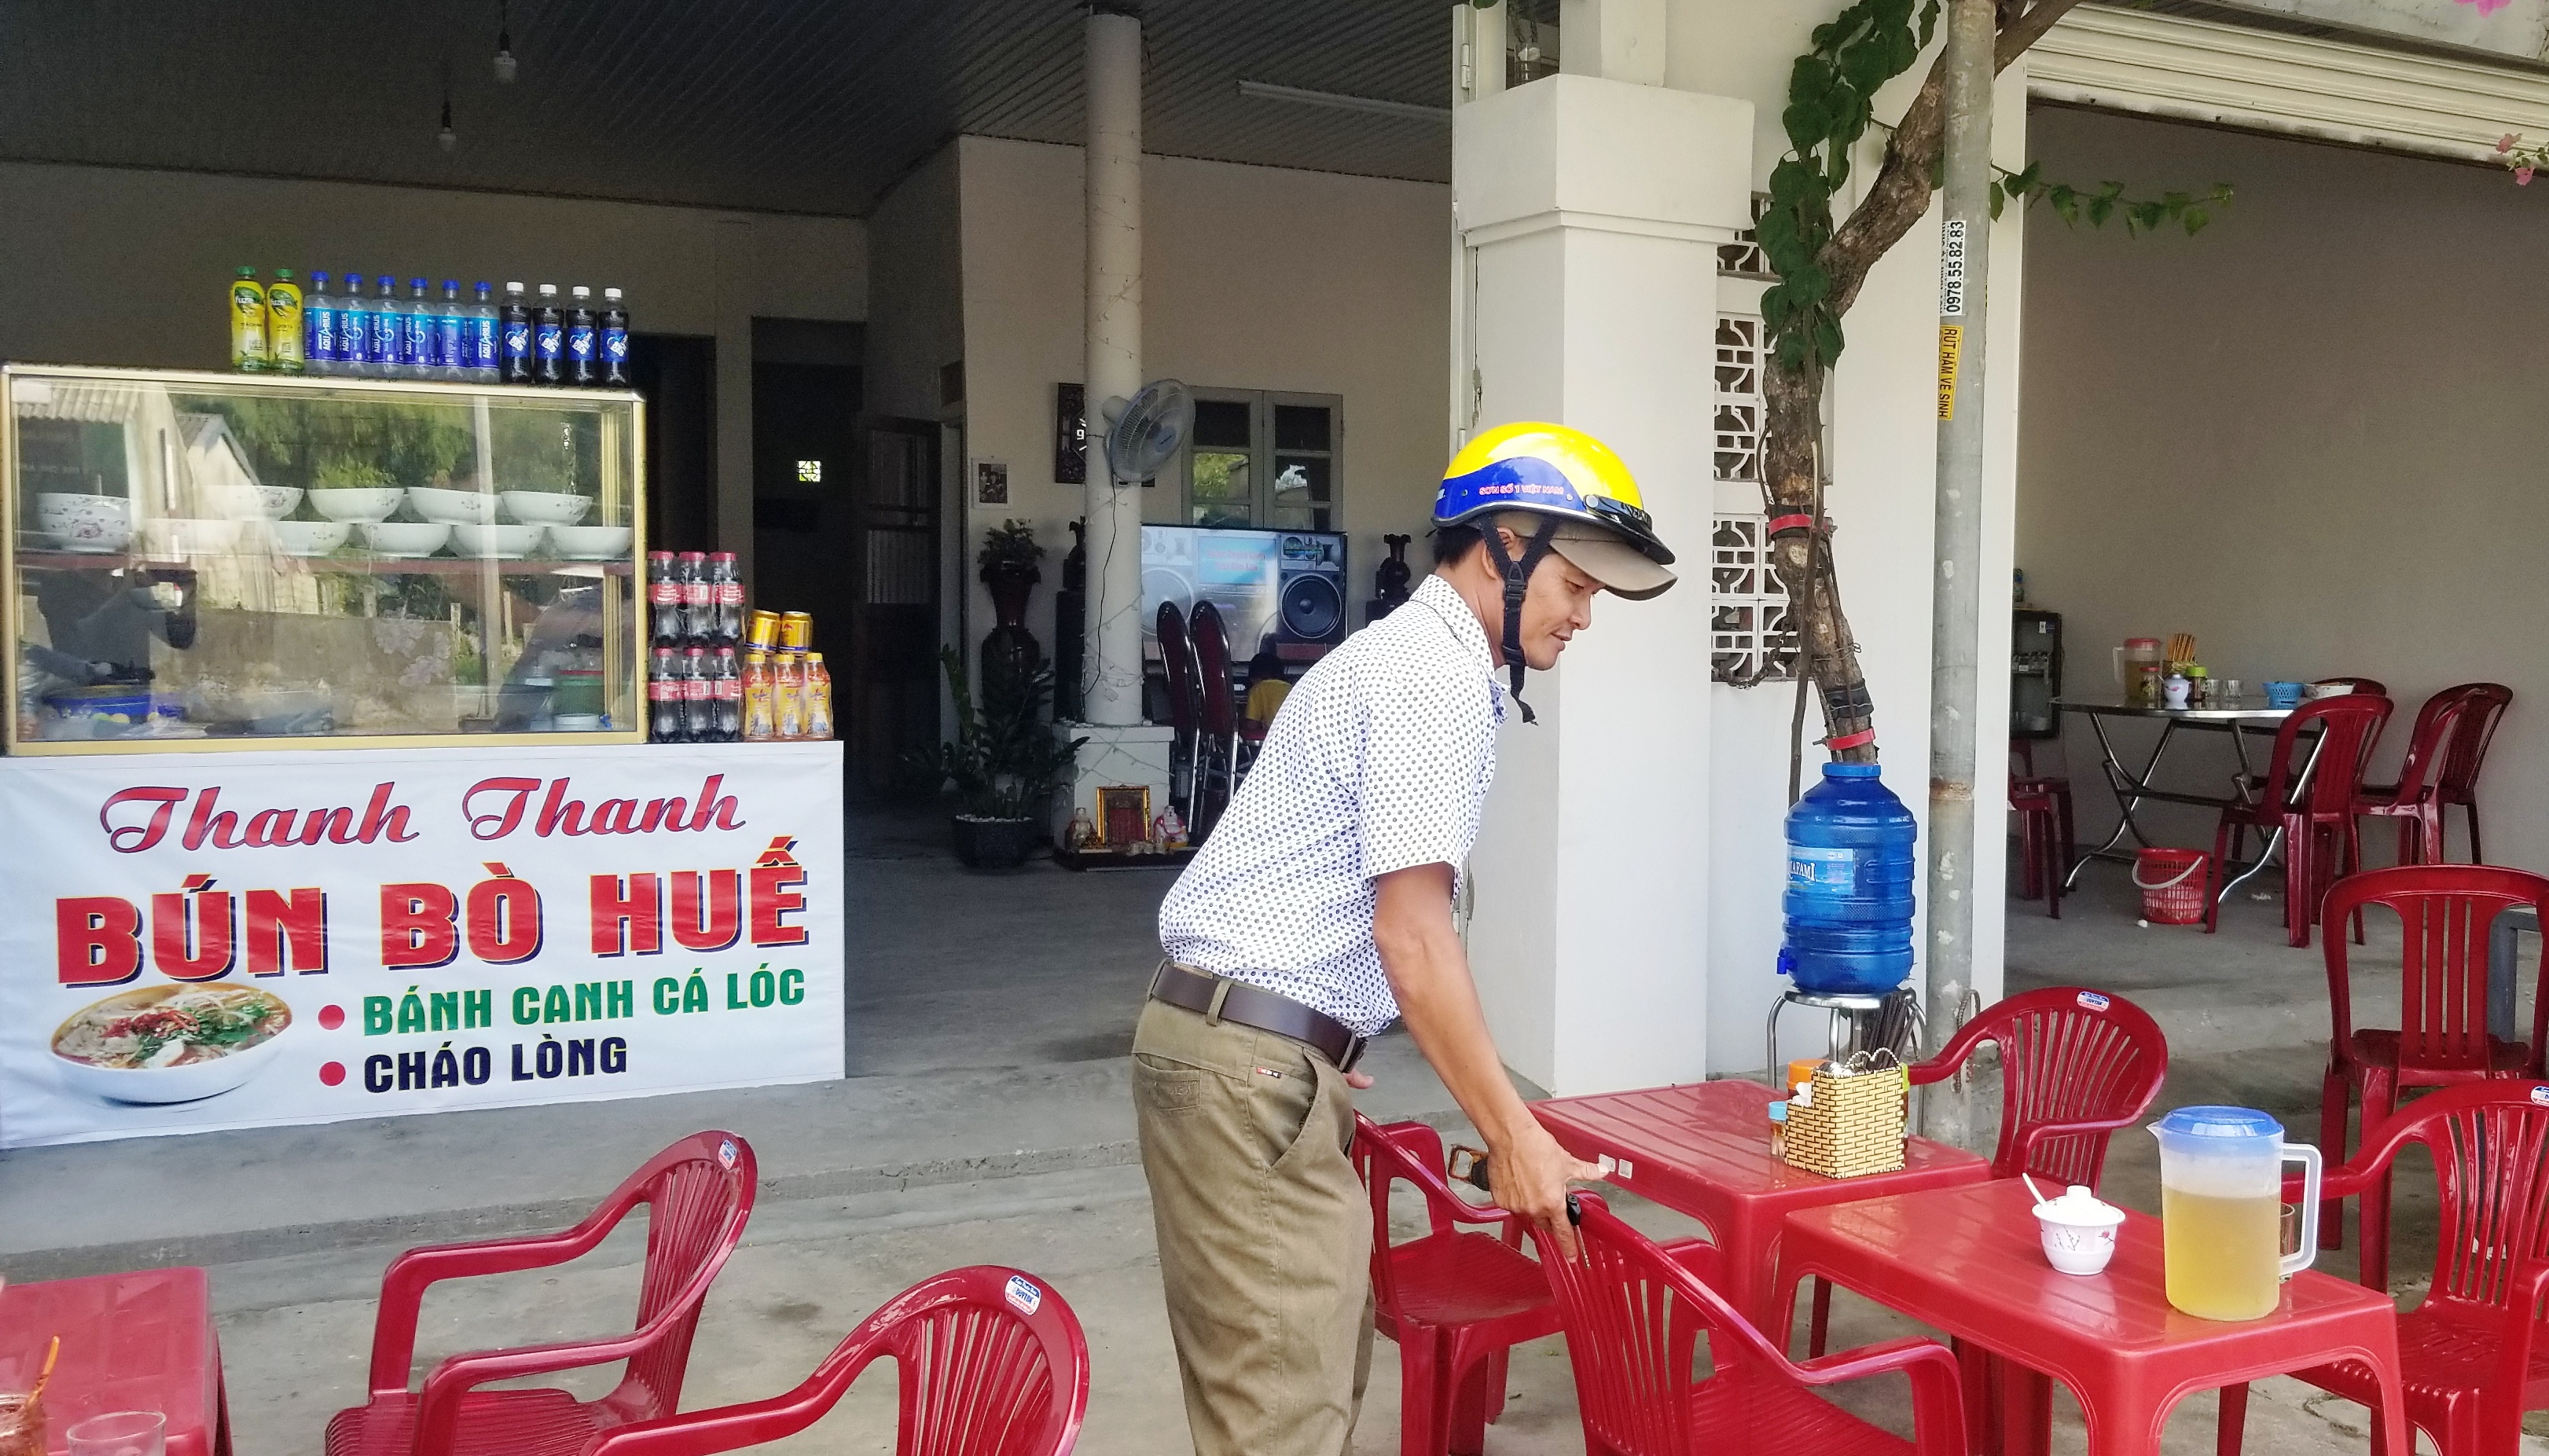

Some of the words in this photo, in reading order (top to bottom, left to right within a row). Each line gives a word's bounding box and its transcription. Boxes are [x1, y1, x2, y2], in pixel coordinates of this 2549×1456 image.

[1946, 221, 1965, 313] 0978.55.82.83
[320, 311, 332, 351] AQUARIUS
[480, 320, 491, 359] AQUARIUS
[1944, 328, 1959, 349] RÚT
[1938, 394, 1950, 418] SINH
[101, 782, 420, 853] Thanh
[462, 774, 745, 841] Thanh
[56, 874, 329, 989] BÚN
[380, 862, 544, 971] BÒ
[590, 834, 810, 955] HUẾ
[363, 985, 492, 1036] BÁNH
[512, 980, 634, 1025] CANH
[652, 967, 709, 1016] CÁ
[727, 963, 805, 1010] LÓC
[364, 1047, 491, 1094] CHÁO
[511, 1035, 627, 1081] LÒNG
